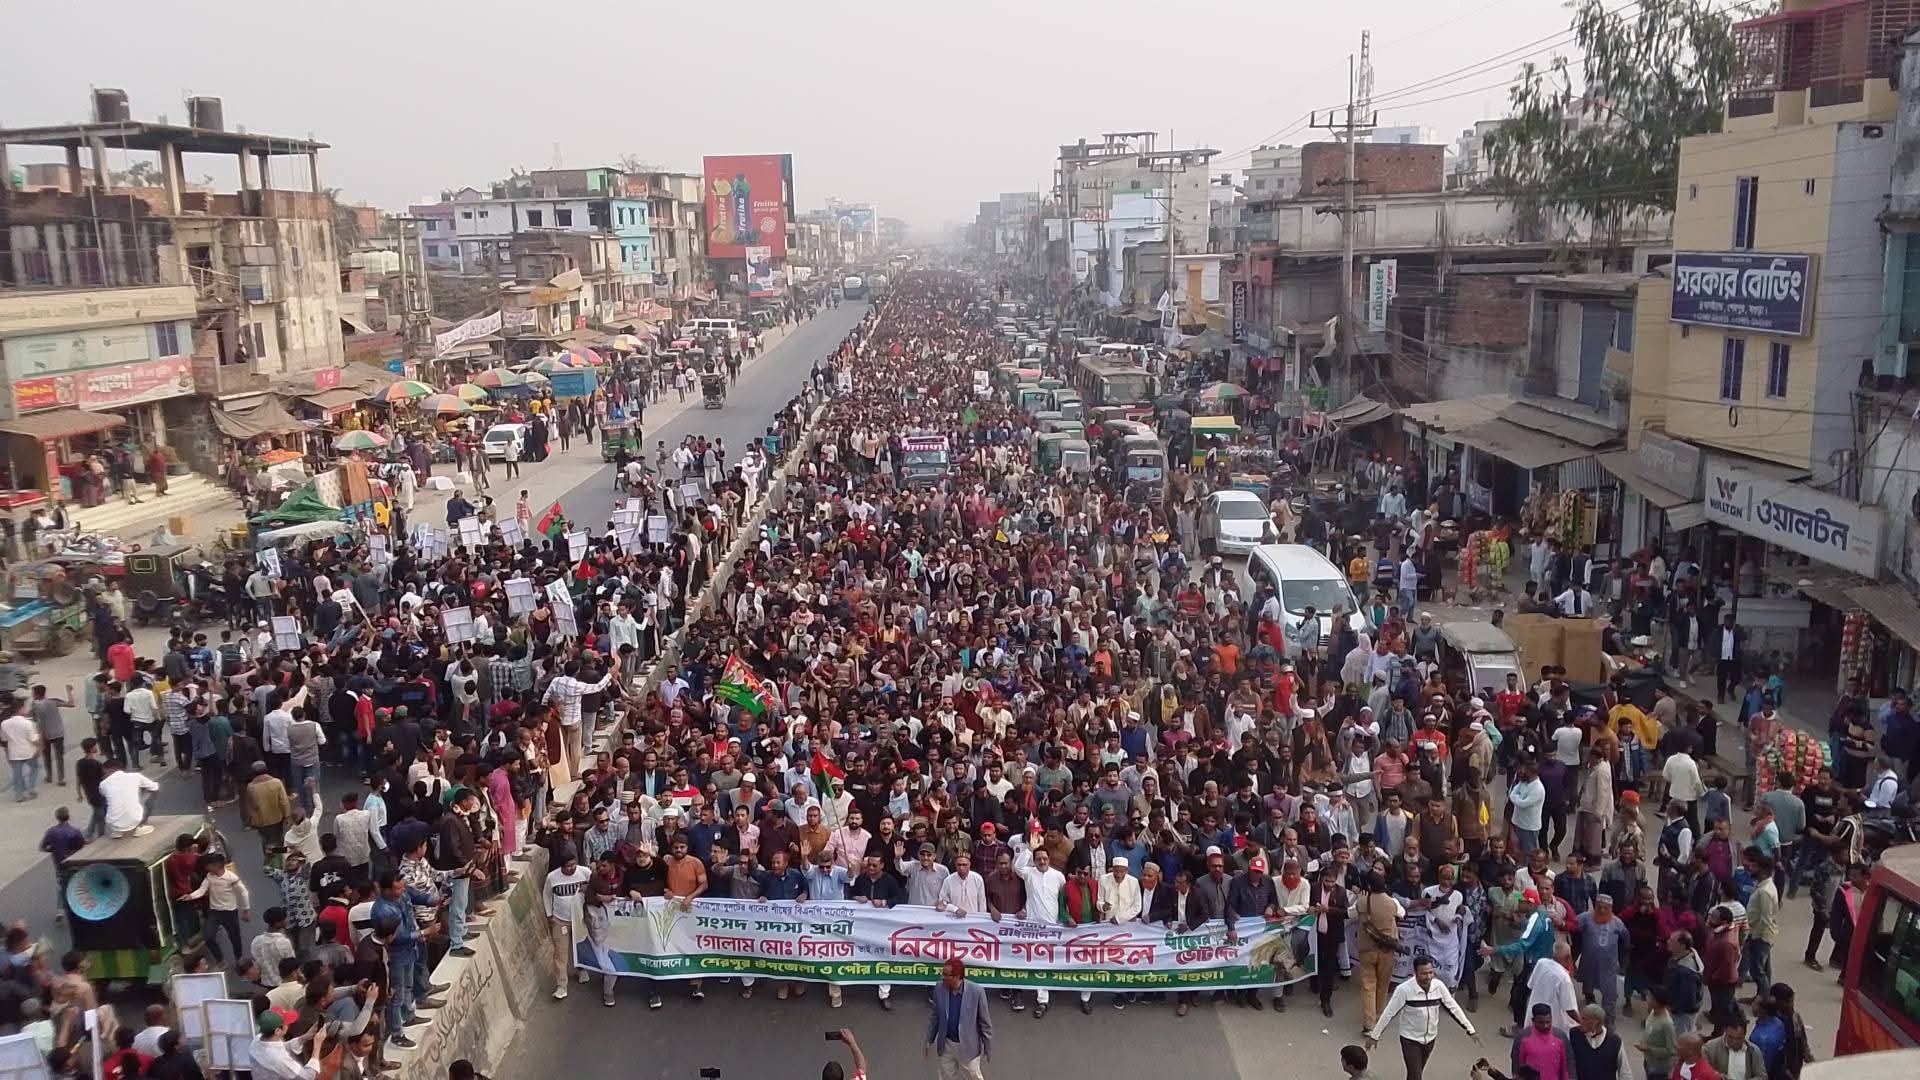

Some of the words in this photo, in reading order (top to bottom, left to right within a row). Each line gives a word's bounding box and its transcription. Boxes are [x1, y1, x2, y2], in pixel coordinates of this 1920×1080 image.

[1677, 265, 1740, 299] সরকার
[1709, 498, 1743, 519] WALTON
[1757, 498, 1850, 551] ওয়ালটন
[795, 905, 821, 917] বিএনপি
[696, 916, 748, 930] সংসদ
[755, 920, 803, 934] সদস্য
[999, 926, 1062, 940] বাংলাদেশ
[696, 933, 755, 953] গোলাম
[760, 938, 793, 956] মোঃ
[797, 935, 855, 959] সিরাজ
[888, 926, 1001, 962] নির্বাচনী
[1012, 942, 1056, 963] গণ
[1065, 933, 1157, 965] মিছিল
[1175, 946, 1213, 965] ভোট
[638, 957, 682, 969] আয়োজনে
[700, 957, 750, 971] শেরপুর
[755, 960, 815, 974] উপজেলা
[820, 964, 832, 975] ও
[838, 961, 871, 976] পৌর
[876, 961, 929, 976] বিএনপি
[1052, 970, 1111, 983] সহযোগী
